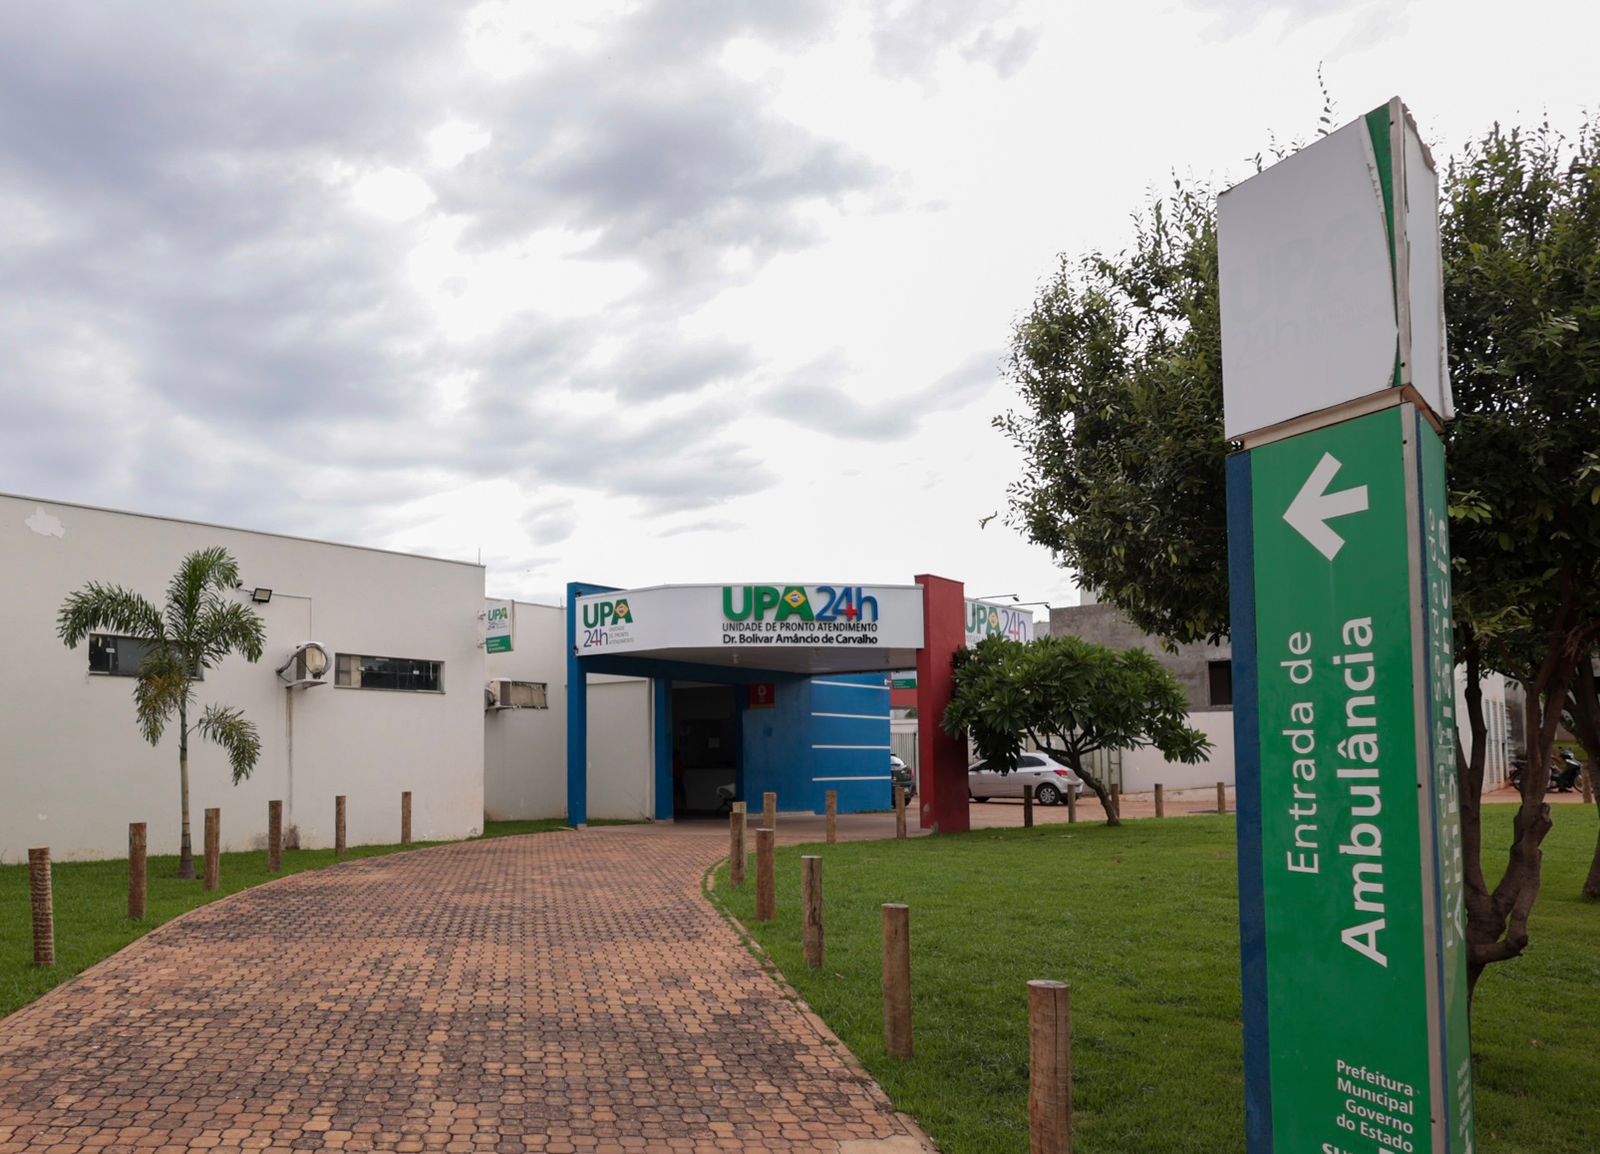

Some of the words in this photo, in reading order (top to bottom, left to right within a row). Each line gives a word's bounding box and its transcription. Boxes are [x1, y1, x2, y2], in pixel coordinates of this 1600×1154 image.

[487, 607, 508, 621] UPA
[583, 599, 633, 629] UPA
[722, 622, 763, 632] UNIDADE
[765, 622, 777, 632] DE
[780, 622, 816, 632] PRONTO
[816, 622, 878, 633] ATENDIMENTO
[965, 603, 1001, 635] UPA
[1001, 608, 1027, 641] 24h
[583, 629, 609, 648] 24h
[723, 633, 738, 644] Dr.
[775, 633, 820, 645] Amâncio
[821, 633, 835, 644] de
[835, 633, 878, 645] Carvalho
[1280, 631, 1313, 685] de
[1286, 701, 1320, 874] Entrada
[1332, 616, 1388, 968] Ambulância
[1336, 1059, 1413, 1097] Prefeitura
[1337, 1077, 1413, 1115] Municipal
[1336, 1113, 1356, 1131] do
[1360, 1121, 1413, 1153] Estado
[1345, 1099, 1413, 1135] Governo
